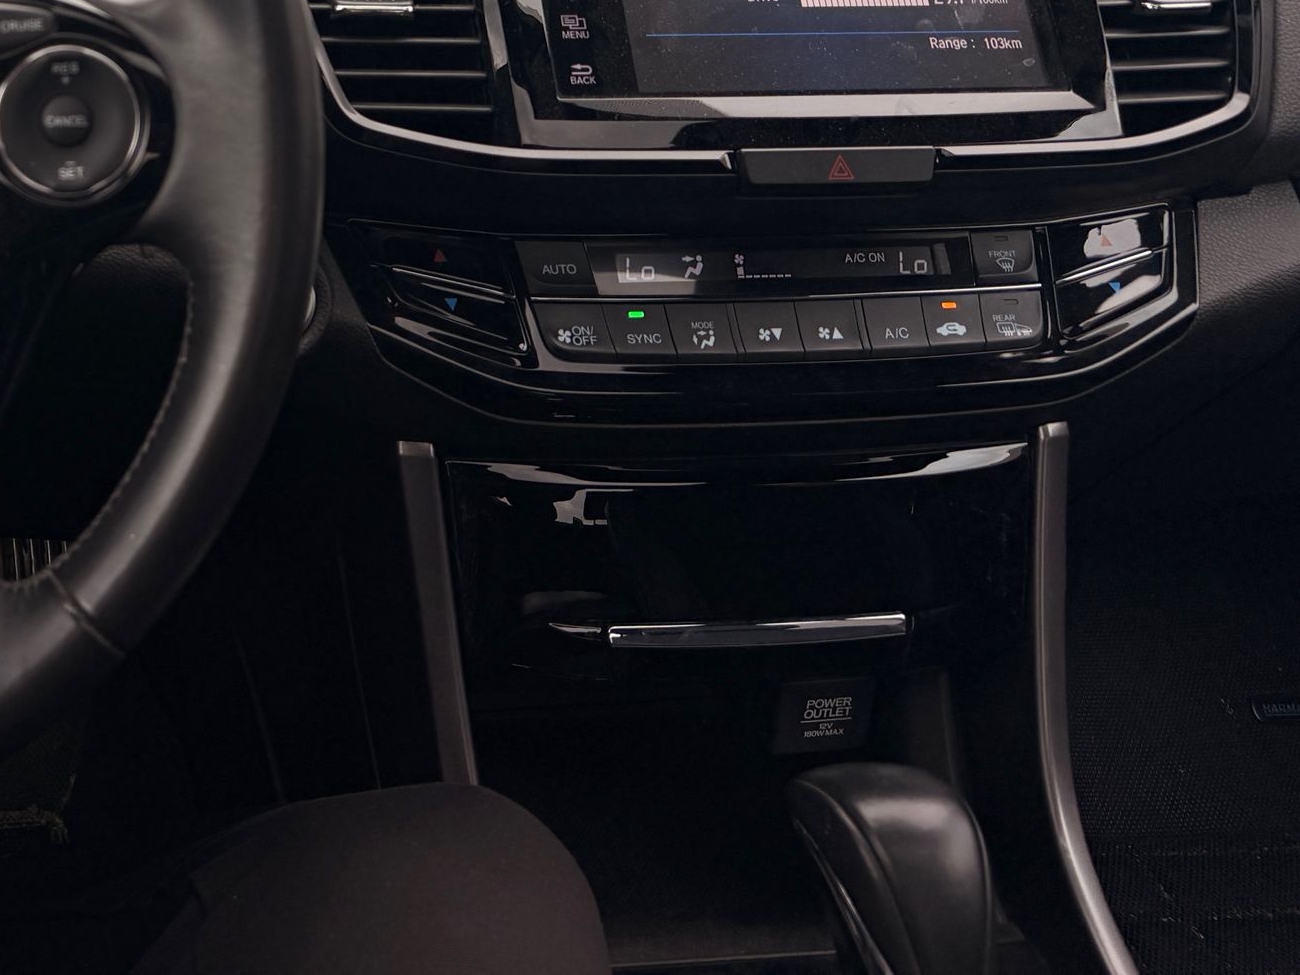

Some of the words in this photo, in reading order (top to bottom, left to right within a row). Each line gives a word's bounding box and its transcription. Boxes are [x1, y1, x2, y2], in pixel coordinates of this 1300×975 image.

[562, 31, 590, 39] MENU
[983, 37, 1023, 49] 103km
[570, 76, 597, 85] BACK
[844, 252, 866, 263] A/C
[868, 251, 886, 263] ON
[988, 249, 1016, 259] FRONT
[542, 263, 578, 275] AUTO
[626, 257, 655, 281] Lo
[899, 251, 928, 275] Lo
[992, 314, 1016, 323] REAR
[572, 325, 594, 337] ON/
[691, 321, 714, 330] MODE
[626, 333, 662, 345] SYNC
[884, 327, 910, 339] A/C
[572, 335, 598, 346] OFF
[806, 697, 852, 709] POWER
[804, 707, 852, 720] OUTLET
